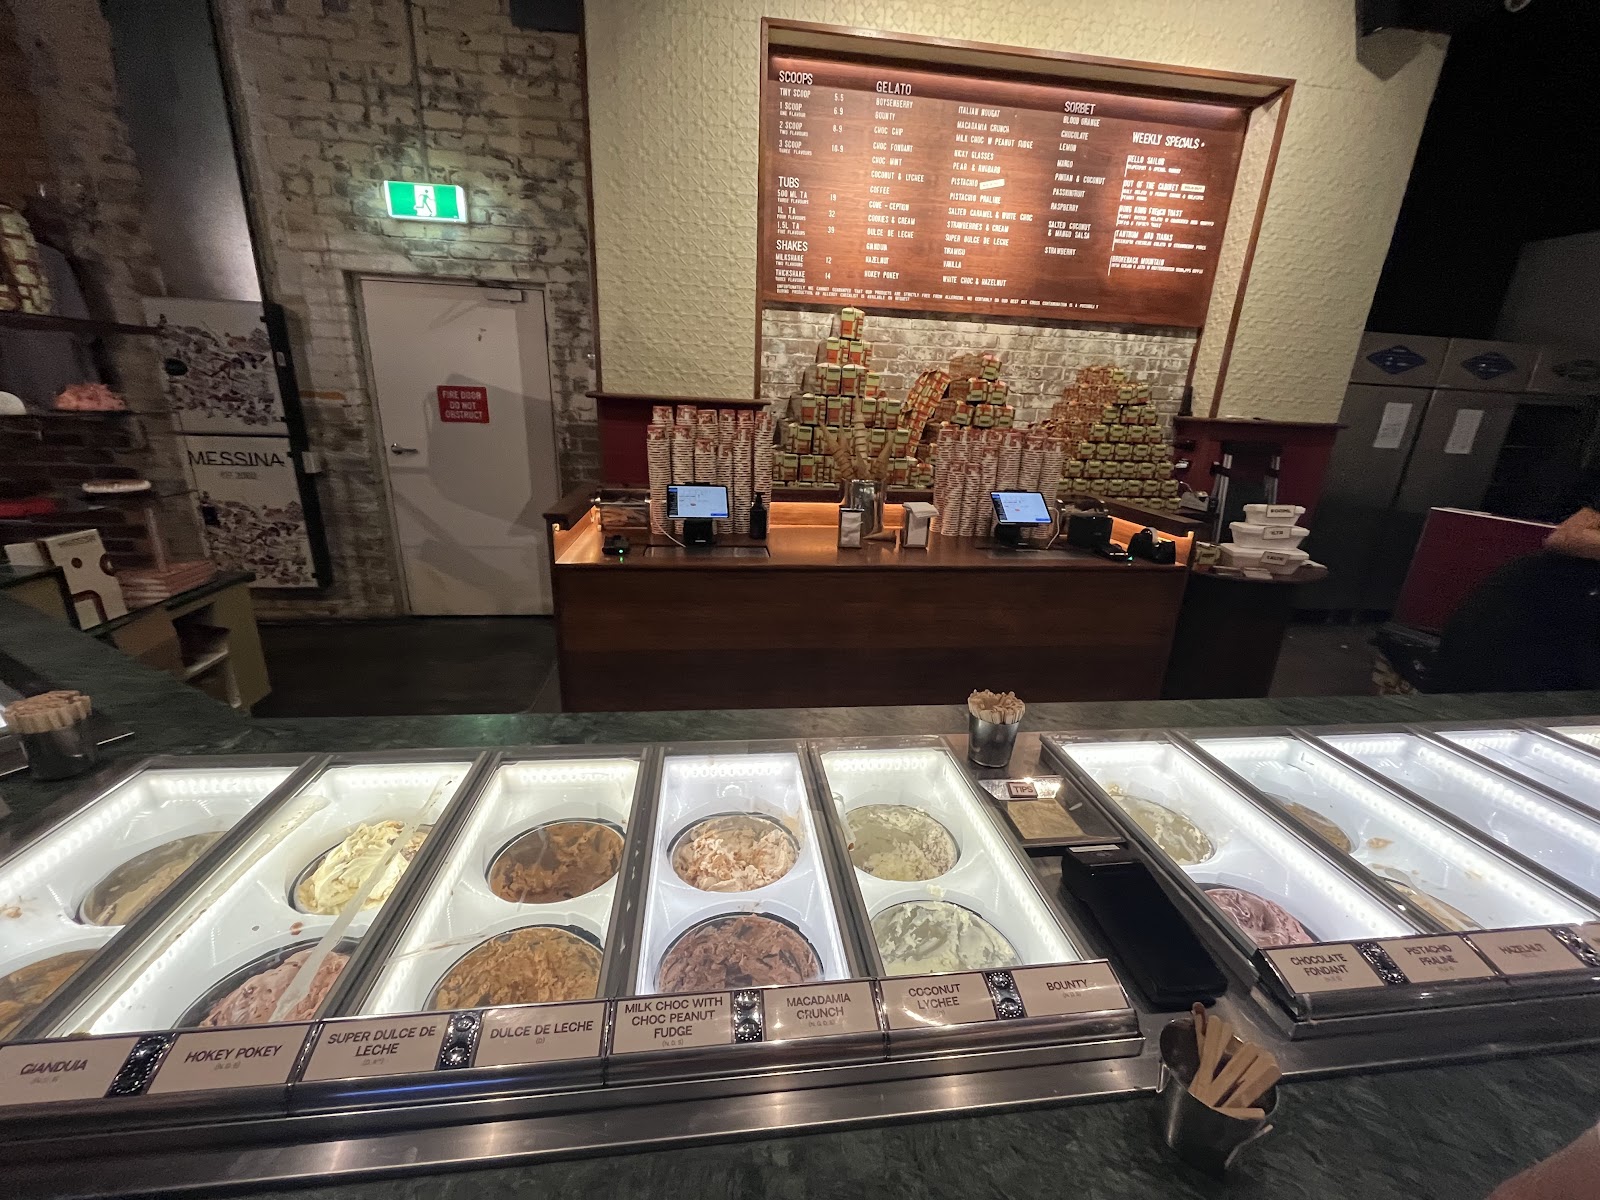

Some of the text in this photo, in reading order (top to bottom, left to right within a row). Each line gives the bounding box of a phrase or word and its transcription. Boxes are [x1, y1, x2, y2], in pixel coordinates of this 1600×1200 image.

[779, 70, 813, 86] SCOOPS
[793, 88, 811, 98] SCOOP
[876, 80, 912, 95] GELATO
[784, 102, 803, 111] SCOOP
[958, 106, 979, 116] ITALIAN
[1064, 100, 1096, 115] SORBET
[784, 121, 803, 130] SCOOP
[874, 126, 888, 135] CHOC
[779, 140, 783, 148] 3
[784, 140, 802, 148] SCOOP
[872, 142, 887, 150] CHOC
[994, 138, 1015, 147] PEANUT
[1132, 132, 1200, 149] WEEKLY SPECIALS
[872, 156, 886, 165] CHOC
[952, 162, 967, 170] PEAR
[871, 170, 895, 180] COCONUT
[778, 176, 800, 188] TUBS
[777, 190, 788, 198] 500
[800, 191, 808, 199] TA
[869, 185, 890, 194] COFFEE
[788, 206, 796, 215] TA
[828, 210, 836, 218] 32
[948, 207, 966, 216] SALTED
[868, 214, 889, 223] COOKIES
[897, 217, 916, 225] CREAM
[792, 222, 800, 230] TA
[776, 239, 808, 251] SHAKES
[442, 390, 481, 400] FIRE DOOR
[450, 401, 476, 410] DO NOT
[445, 410, 482, 419] OBSTRUCT
[187, 450, 285, 467] MESSINA
[1497, 943, 1547, 954] HAZELNUT
[1290, 953, 1347, 966] CHOCOLATE
[1303, 965, 1349, 976] FONDANT
[908, 984, 961, 997] COCONUT
[1046, 979, 1088, 992] BOUNTY
[624, 997, 723, 1014] MILK CHOC WITH
[786, 992, 851, 1008] MACADAMIA
[917, 997, 960, 1010] LYCHEE
[631, 1010, 715, 1026] CHOC PEANUT
[796, 1006, 845, 1020] CRUNCH
[328, 1026, 437, 1045] SUPER DULCE DE
[490, 1020, 594, 1039] DULCE DE LECHE
[654, 1026, 693, 1039] FUDGE
[184, 1045, 283, 1063] HOKEY POKEY
[354, 1044, 399, 1058] LECHE
[20, 1059, 88, 1075] GIANDUIA
